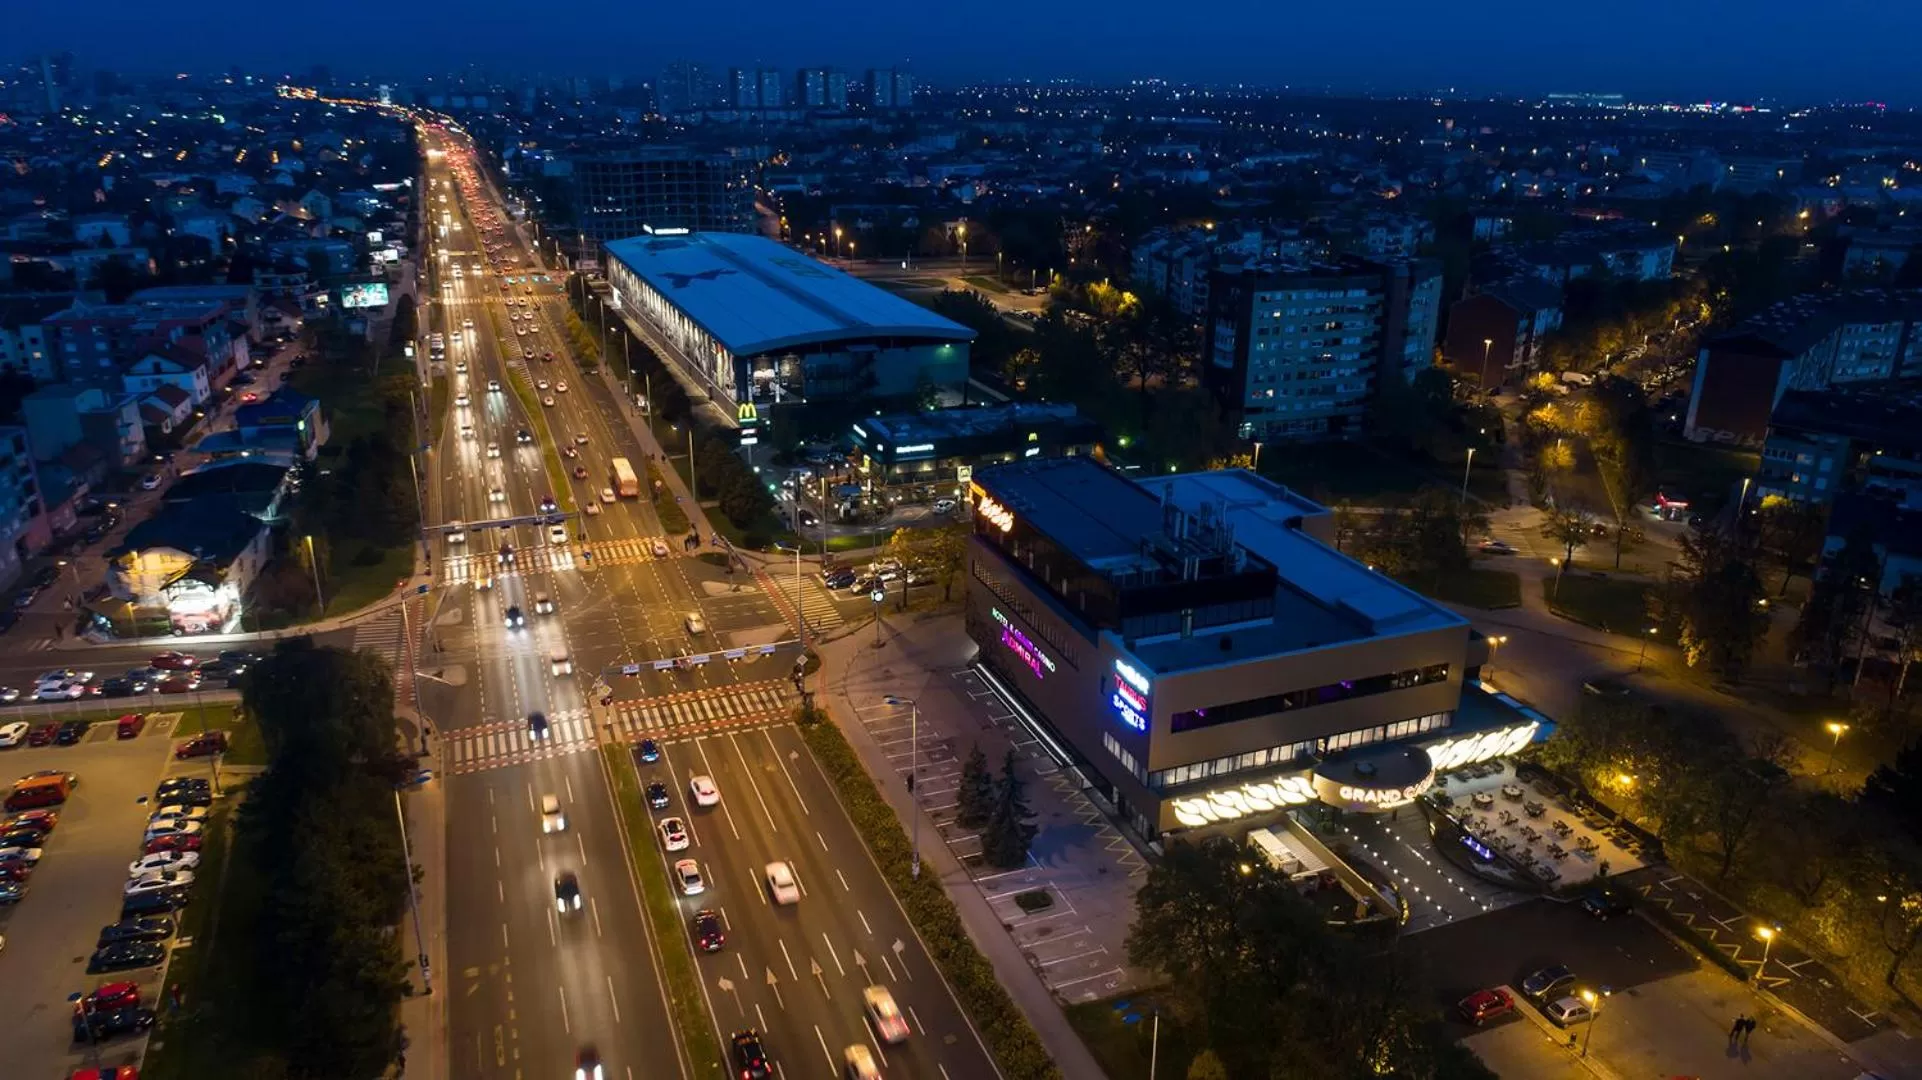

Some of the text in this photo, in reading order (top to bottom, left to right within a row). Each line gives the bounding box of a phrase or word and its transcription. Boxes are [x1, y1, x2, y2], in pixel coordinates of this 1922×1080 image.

[1001, 630, 1044, 680] ADMIRAL
[1113, 694, 1145, 730] SPORTS
[1339, 785, 1402, 803] GRAND
